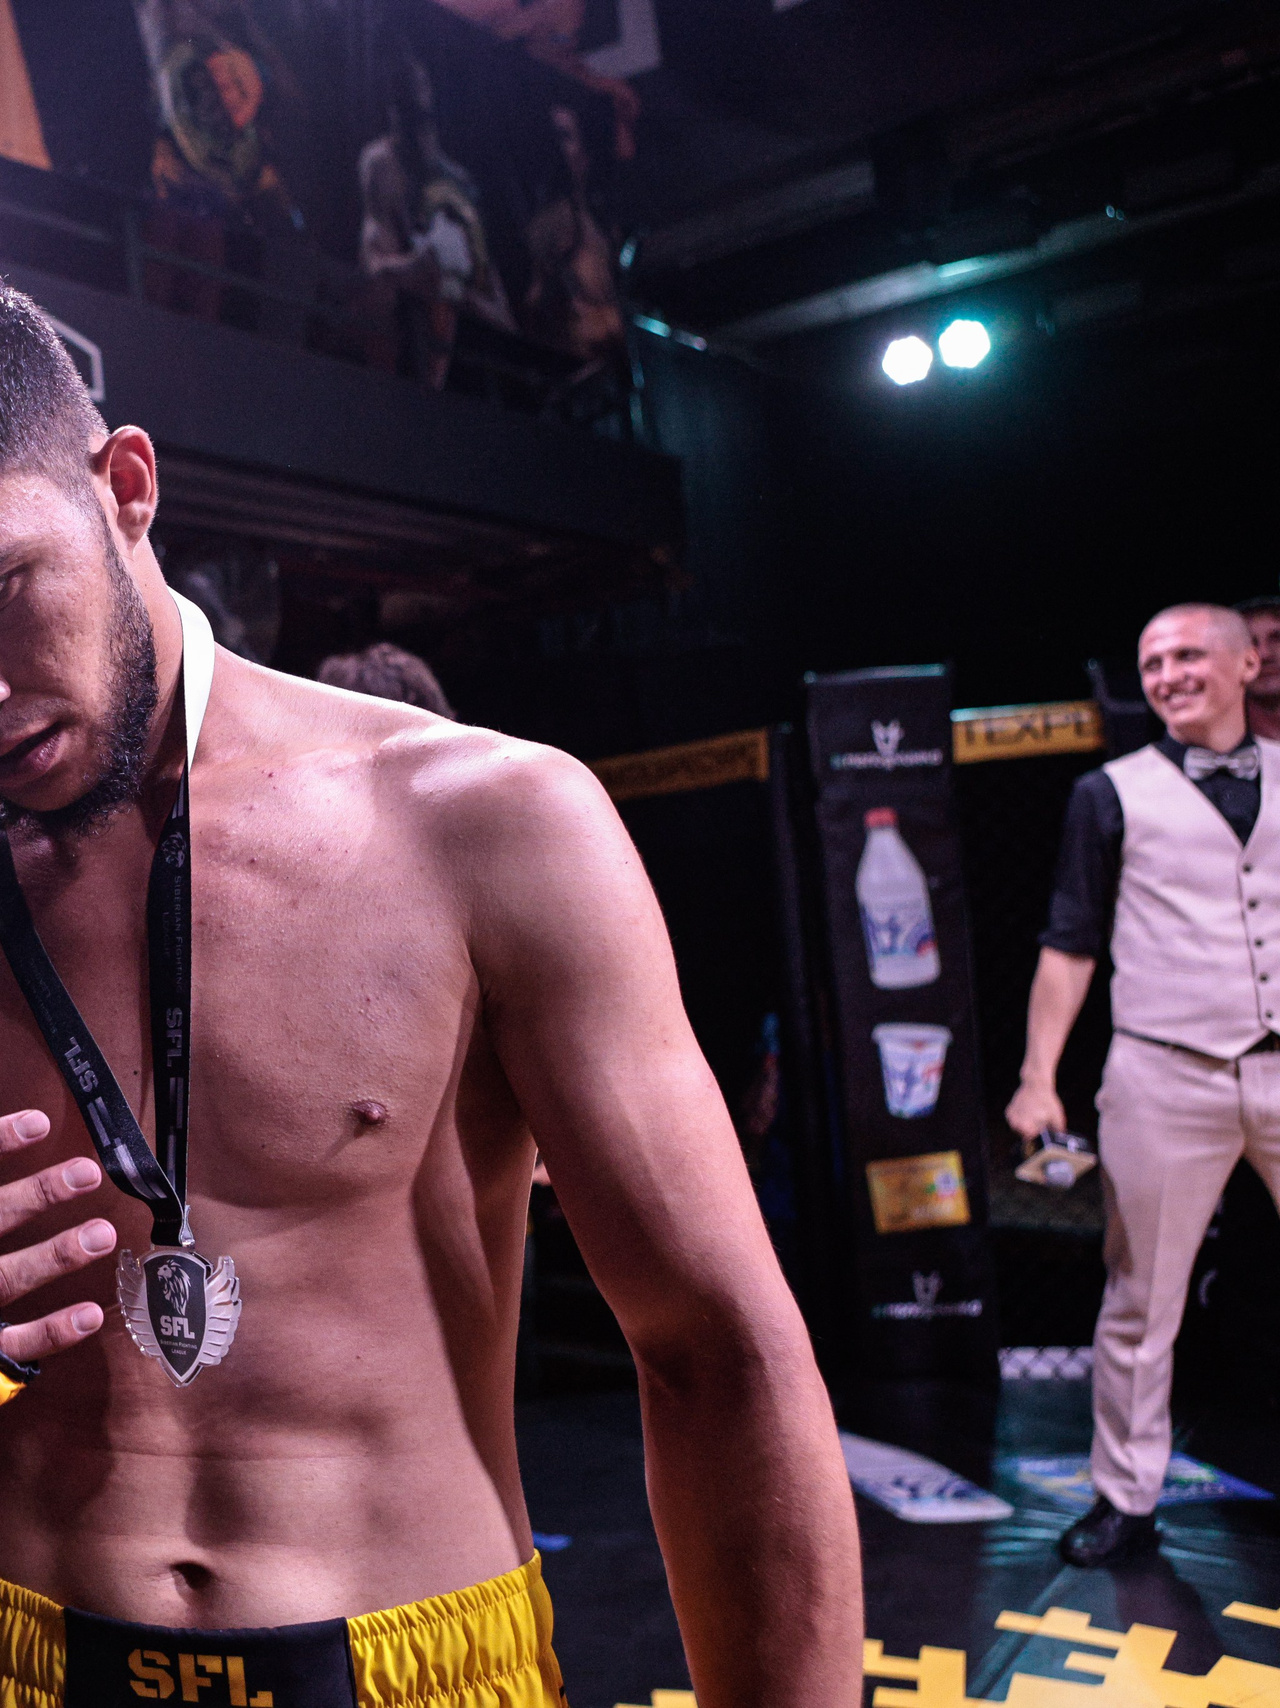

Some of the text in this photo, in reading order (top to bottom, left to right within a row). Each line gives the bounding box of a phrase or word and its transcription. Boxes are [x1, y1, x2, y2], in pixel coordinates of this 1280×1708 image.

[64, 1036, 99, 1093] SFL
[166, 1007, 183, 1067] SFL
[160, 1315, 196, 1339] SFL
[128, 1649, 273, 1707] SFL
